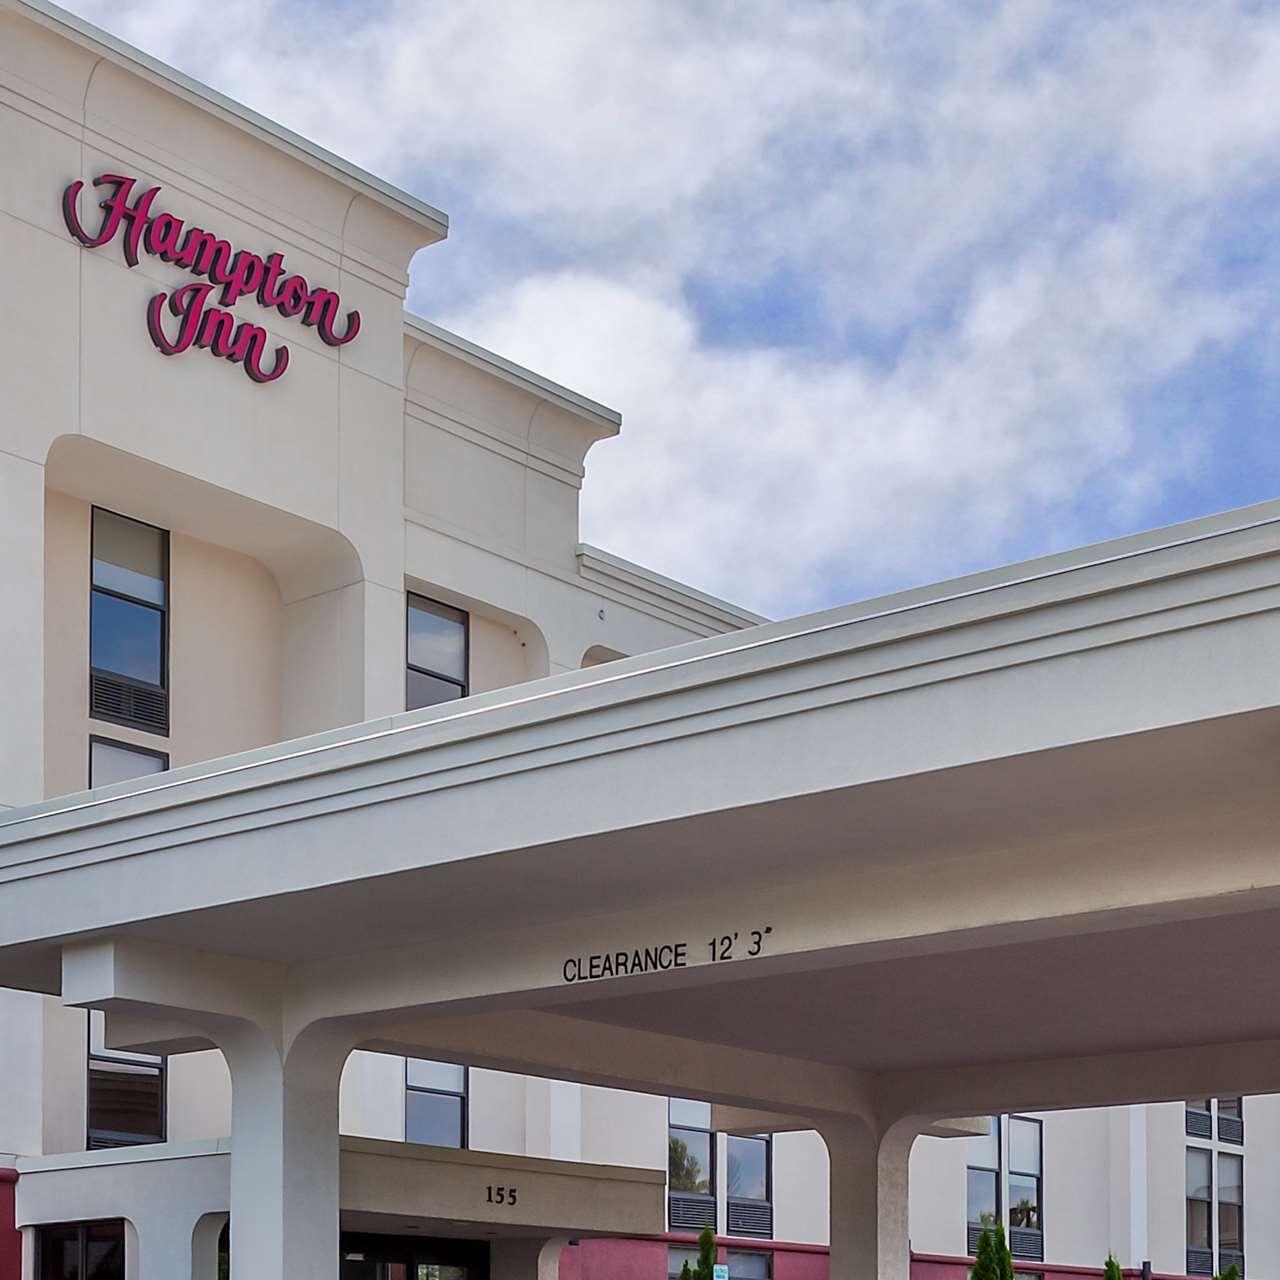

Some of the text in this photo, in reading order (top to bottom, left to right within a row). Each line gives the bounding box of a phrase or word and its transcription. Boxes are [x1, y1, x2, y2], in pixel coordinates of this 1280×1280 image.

[62, 173, 361, 347] Hampton
[146, 283, 289, 383] Inn
[563, 943, 687, 982] CLEARANCE
[709, 932, 738, 962] 12'
[486, 1186, 517, 1205] 155
